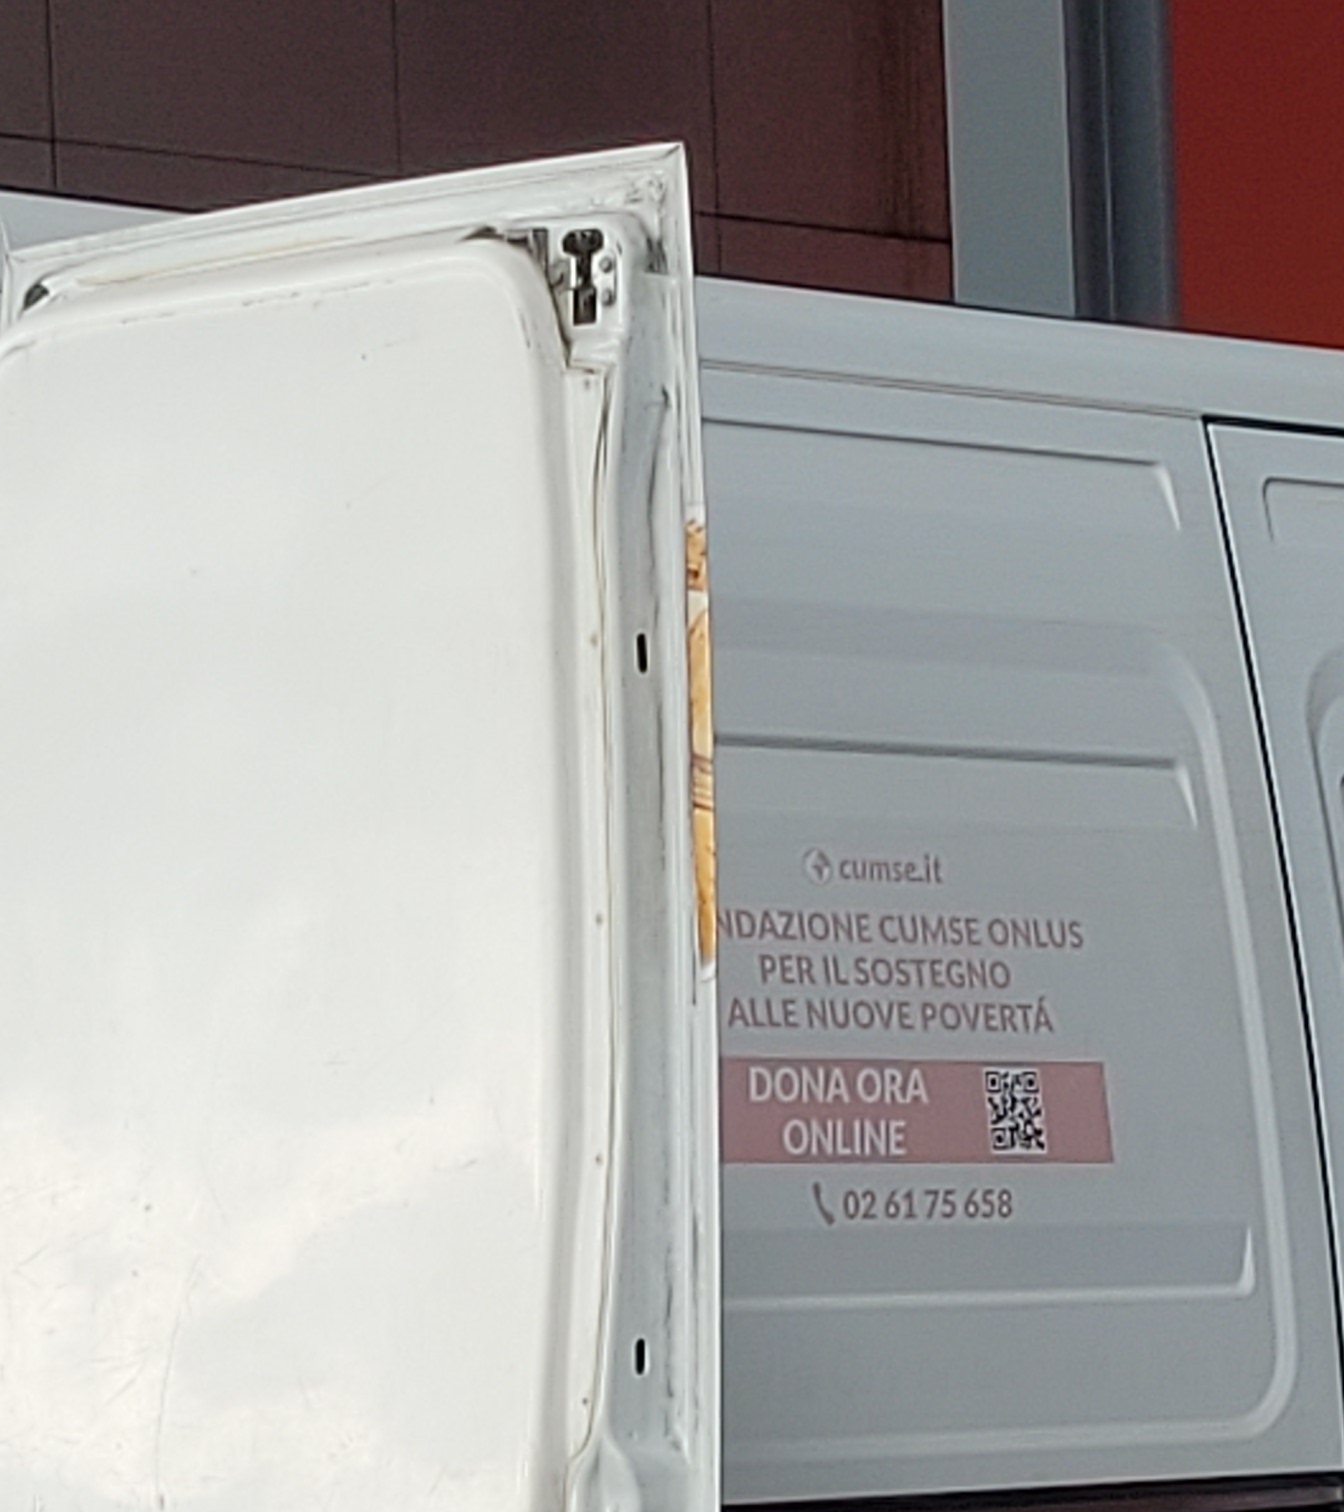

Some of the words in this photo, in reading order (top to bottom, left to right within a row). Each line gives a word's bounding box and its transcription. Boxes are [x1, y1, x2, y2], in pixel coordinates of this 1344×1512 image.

[839, 854, 943, 883] cumse.it
[878, 914, 981, 946] CUMSE
[988, 918, 1084, 949] ONLUS
[759, 954, 816, 985] PER
[823, 955, 849, 986] IL
[854, 956, 1011, 989] SOSTEGNO
[728, 997, 800, 1028] ALLE
[807, 998, 914, 1030] NUOVE
[749, 1066, 849, 1102] DONA
[856, 1068, 929, 1104] ORA
[783, 1119, 906, 1156] ONLINE
[964, 1187, 1012, 1219] 658
